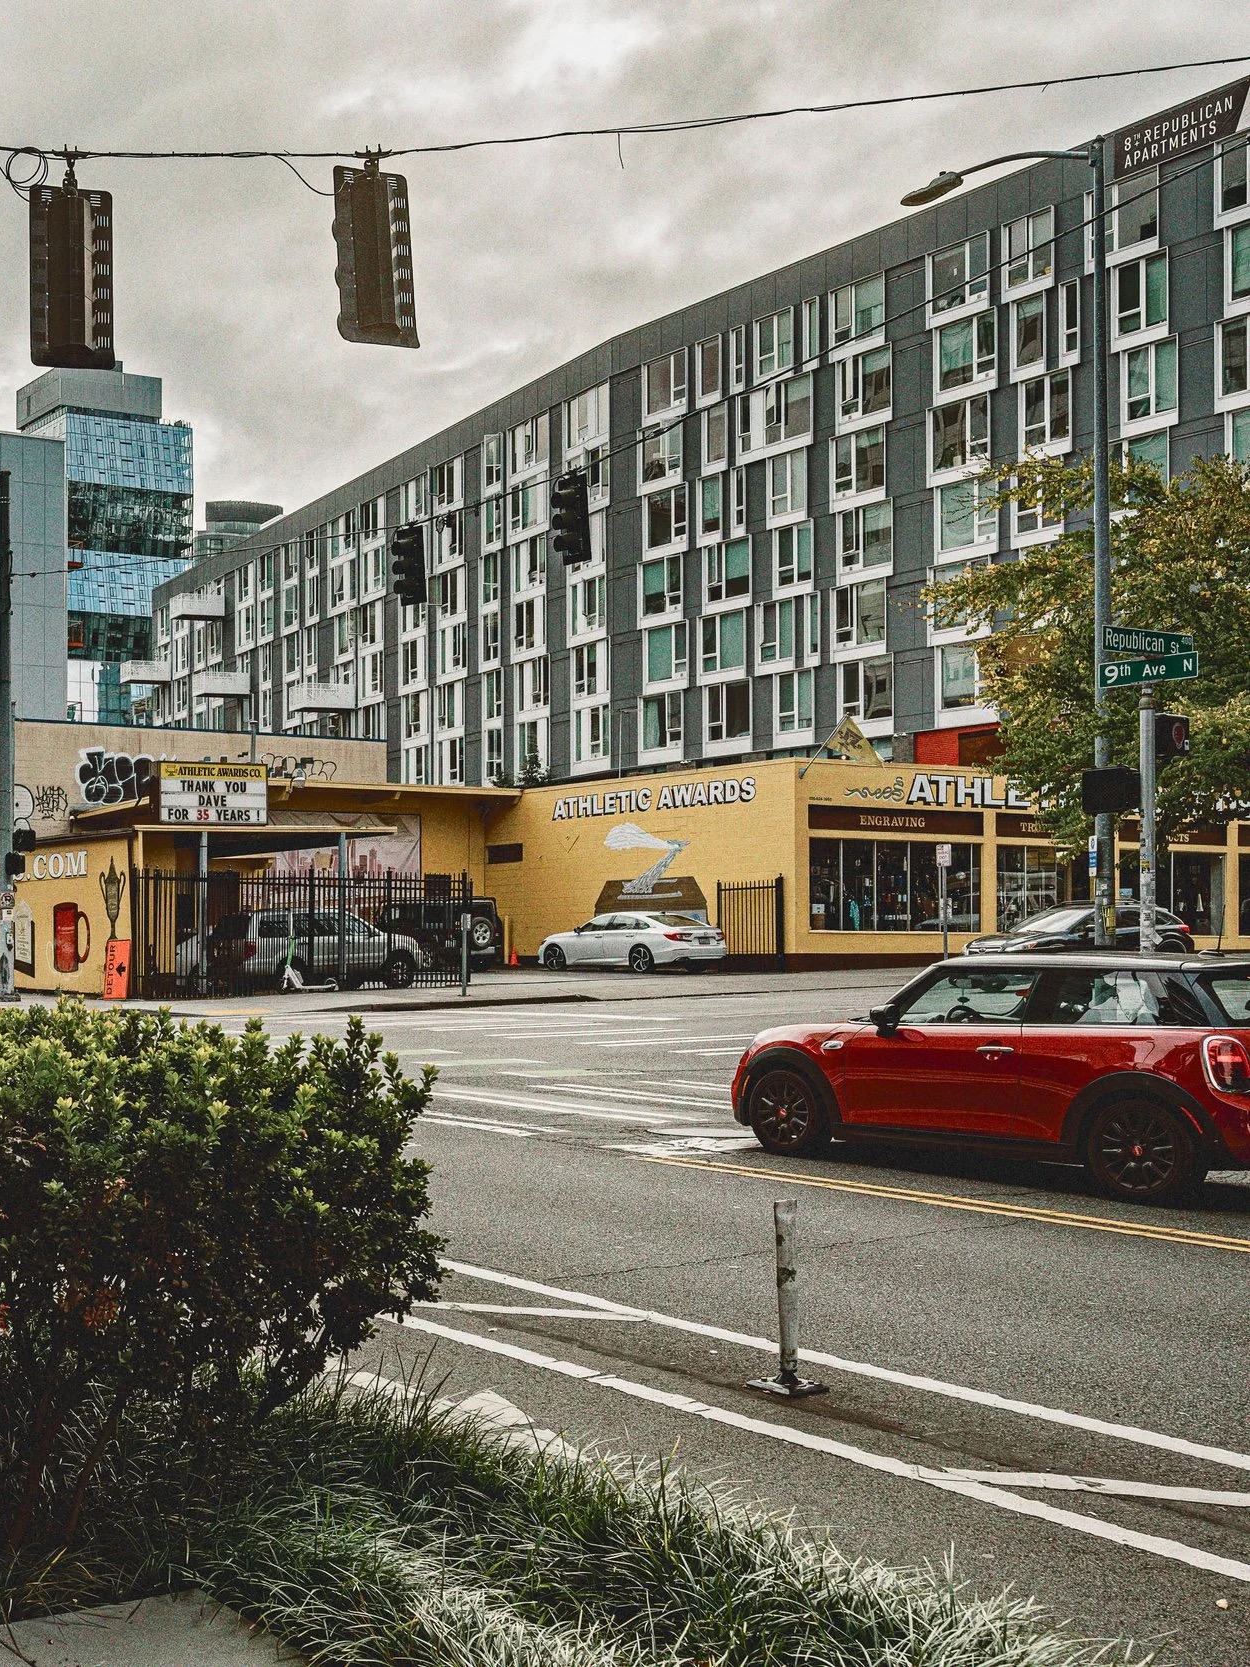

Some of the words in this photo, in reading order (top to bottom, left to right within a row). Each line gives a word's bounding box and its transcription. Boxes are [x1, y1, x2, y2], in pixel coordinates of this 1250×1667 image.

[1143, 95, 1233, 145] REPUBLICAN
[1124, 120, 1217, 169] APARTMENTS
[1105, 627, 1165, 653] Republican
[1170, 641, 1179, 654] St
[1104, 663, 1131, 684] 9th
[1142, 663, 1166, 677] Ave
[1183, 658, 1193, 672] N
[177, 766, 216, 777] ATHLETIC
[216, 767, 249, 778] AWARDS
[249, 768, 262, 778] CO.
[180, 779, 216, 793] THANK
[224, 780, 247, 793] YOU
[552, 787, 652, 821] ATHLETIC
[656, 776, 757, 811] AWARDS
[198, 794, 227, 807] DAVE
[167, 808, 190, 821] FOR
[196, 808, 210, 821] 35
[215, 809, 251, 821] YEARS
[859, 814, 927, 828] ENGRAVING
[106, 944, 117, 995] DETOUR
